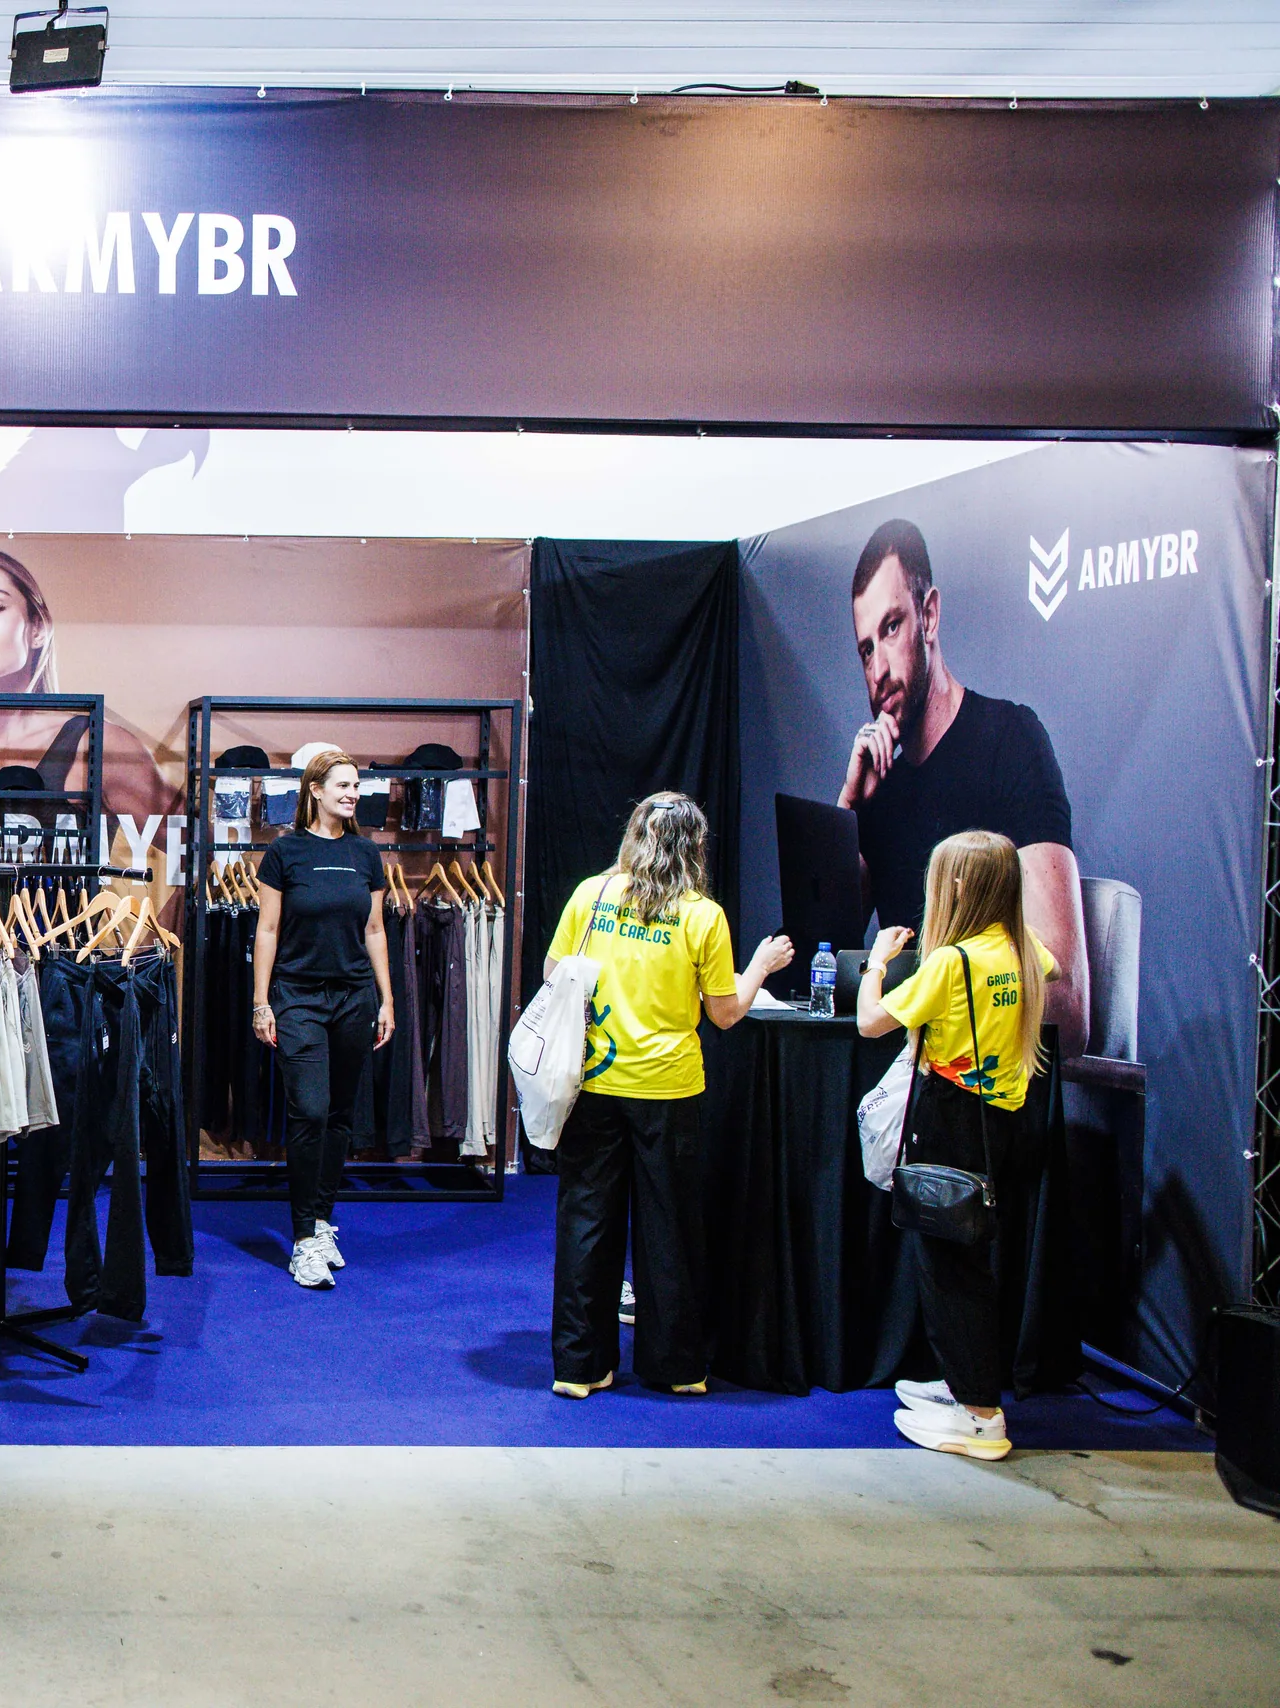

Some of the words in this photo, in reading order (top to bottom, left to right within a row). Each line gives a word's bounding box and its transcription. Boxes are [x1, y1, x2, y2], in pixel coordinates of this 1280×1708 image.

[1077, 529, 1199, 591] ARMYBR
[591, 914, 615, 933] SÃO
[619, 923, 672, 945] CARLOS
[986, 971, 1017, 987] GRUPO
[992, 987, 1018, 1008] SÃO
